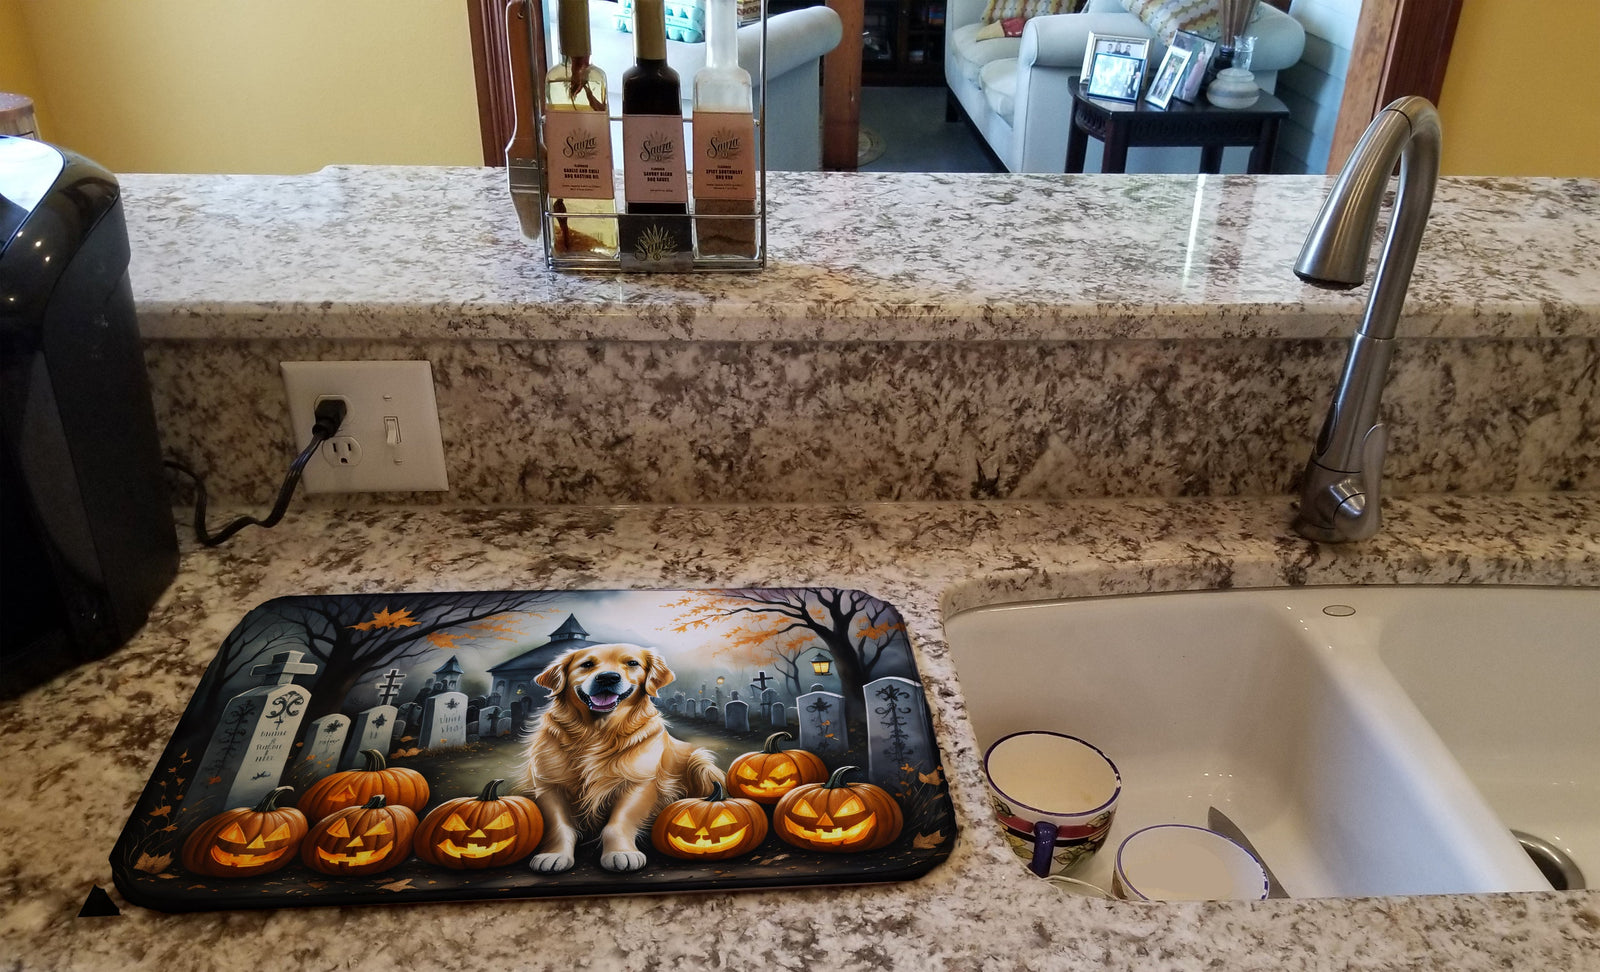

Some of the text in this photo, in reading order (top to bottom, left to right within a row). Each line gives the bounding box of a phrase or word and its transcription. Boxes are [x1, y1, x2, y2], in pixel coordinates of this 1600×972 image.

[563, 136, 597, 158] Sauza
[640, 140, 674, 162] Sauza
[707, 137, 740, 159] Sauza
